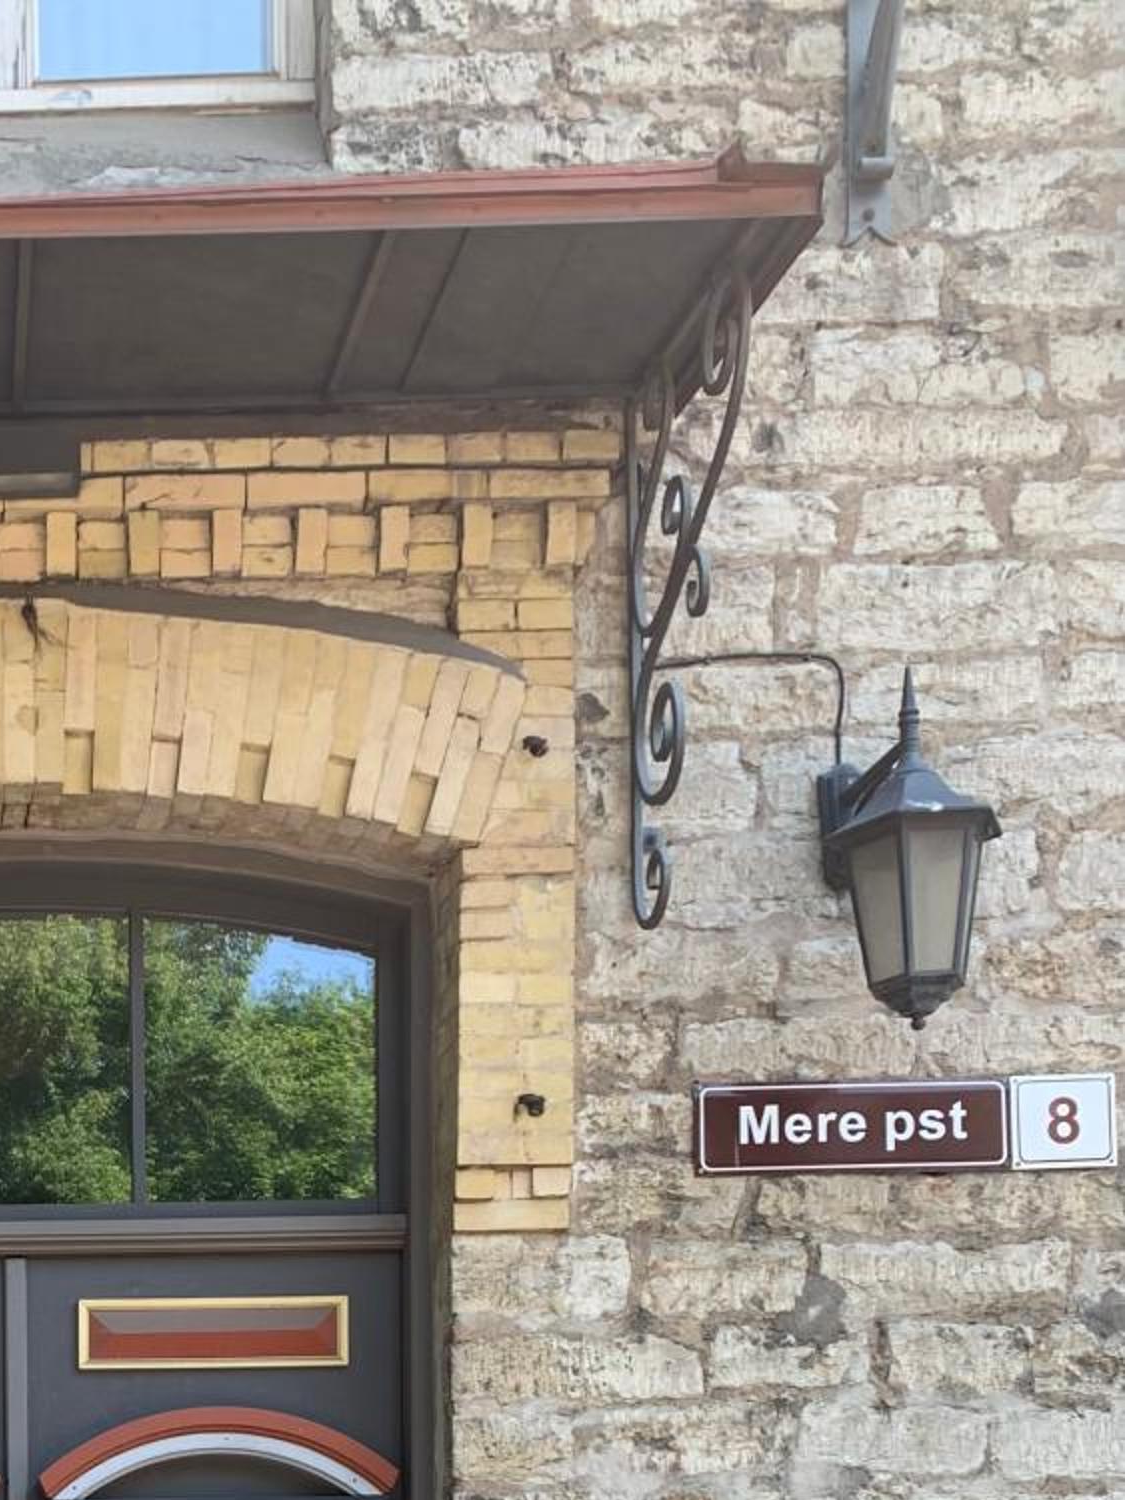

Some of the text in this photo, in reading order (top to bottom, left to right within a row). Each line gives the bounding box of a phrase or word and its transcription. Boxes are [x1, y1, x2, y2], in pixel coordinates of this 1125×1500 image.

[738, 1100, 968, 1151] Mere pst
[1047, 1097, 1080, 1144] 8
